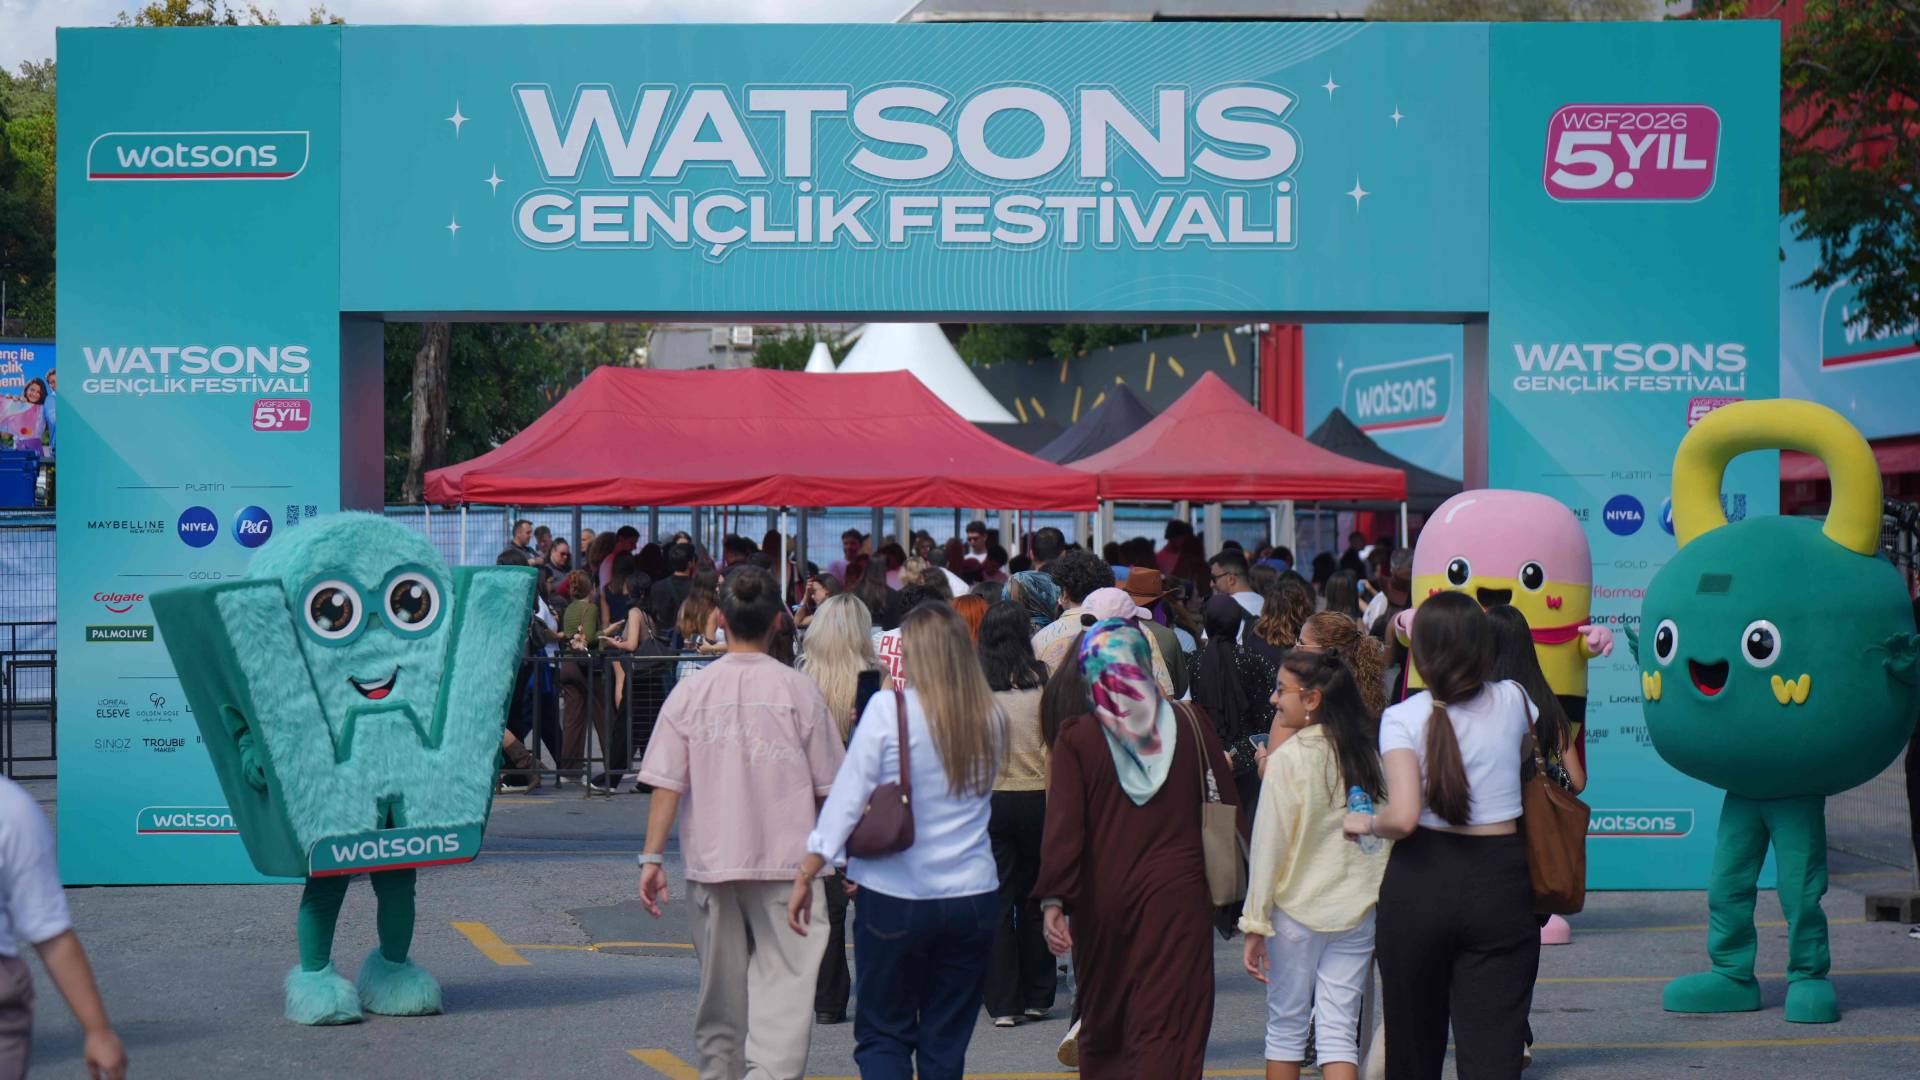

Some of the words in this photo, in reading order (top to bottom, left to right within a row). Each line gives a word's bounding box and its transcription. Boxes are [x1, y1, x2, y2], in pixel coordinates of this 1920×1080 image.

[1562, 112, 1688, 130] WGF2026
[518, 87, 1297, 180] WATSONS
[116, 142, 278, 168] watsons
[518, 181, 874, 257] GENÇLİK
[889, 180, 1292, 244] FESTİVALİ
[82, 345, 310, 374] WATSONS
[1513, 342, 1747, 372] WATSONS
[82, 374, 187, 397] GENÇLİK
[190, 373, 309, 393] FESTİVALİ
[1513, 372, 1619, 395] GENÇLİK
[1624, 372, 1745, 392] FESTİVALİ
[1355, 376, 1438, 418] watsons
[1606, 511, 1642, 521] NIVEA
[87, 520, 165, 529] MAYBELLINE
[181, 522, 215, 532] NIVEA
[239, 519, 269, 534] P&G
[189, 571, 222, 580] GOLD
[93, 591, 145, 604] Colgate
[1590, 612, 1641, 625] parodon
[92, 629, 148, 639] PALMOLIVE
[1612, 663, 1639, 672] SILV
[1609, 694, 1641, 704] LIONE
[96, 708, 131, 719] ELSEVE
[153, 812, 237, 827] watson
[331, 833, 460, 863] watsons
